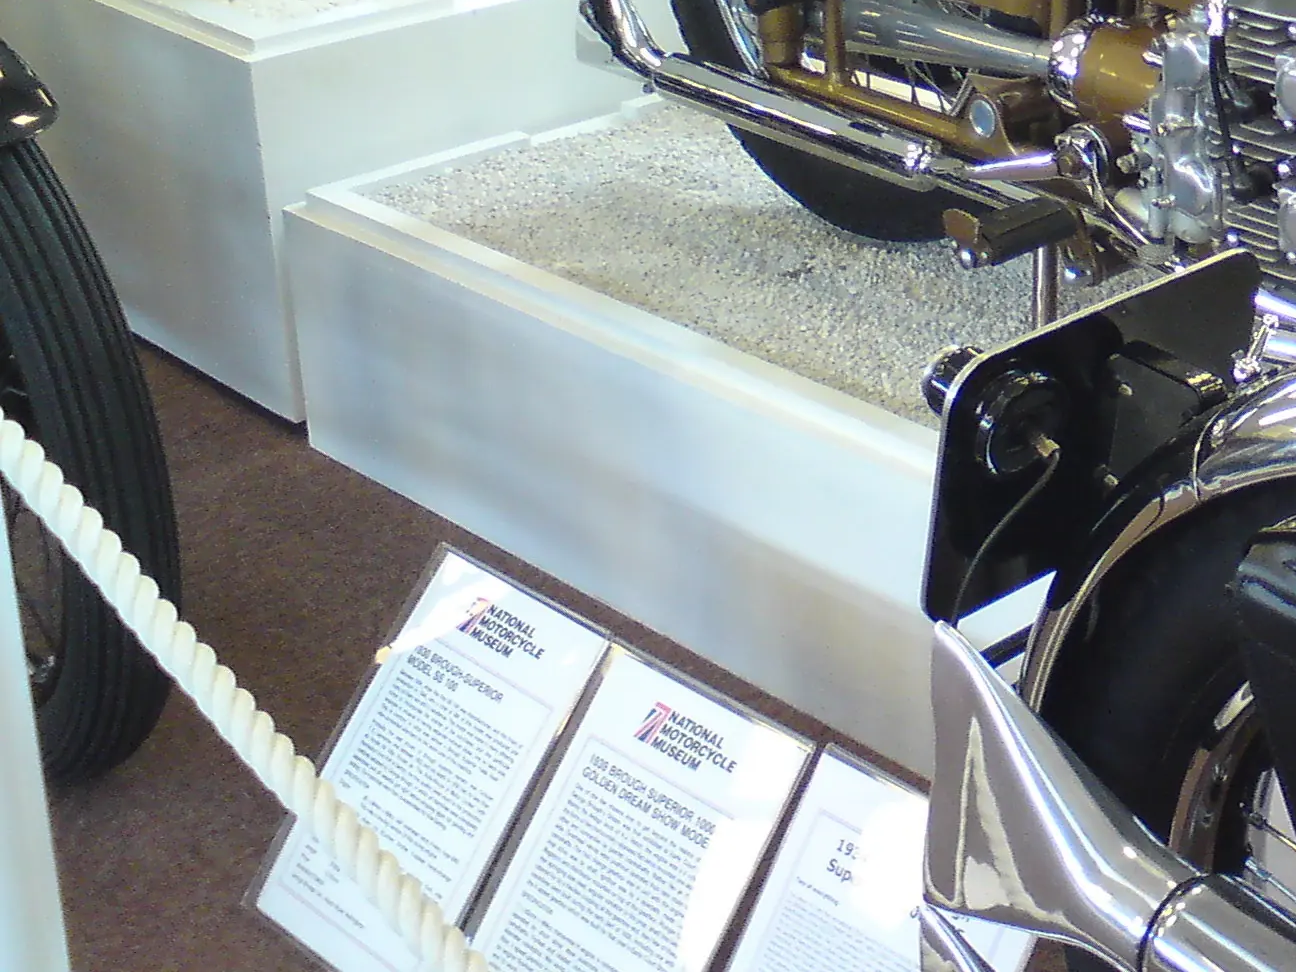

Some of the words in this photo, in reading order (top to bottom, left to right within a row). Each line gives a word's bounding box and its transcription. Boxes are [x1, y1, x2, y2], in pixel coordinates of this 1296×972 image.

[479, 615, 546, 660] MOTORCYCLE
[487, 604, 537, 639] NATIONAL
[469, 627, 515, 658] MUSEUM
[406, 654, 432, 677] MODEL
[659, 723, 738, 773] MOTORCYCLE
[668, 710, 725, 750] NATIONAL
[651, 736, 703, 772] MUSEUM
[582, 766, 619, 795] GOLDEN
[618, 787, 652, 814] DREAM
[651, 807, 681, 831] SHOW
[681, 823, 712, 850] MODE
[608, 764, 648, 794] BROUGH
[647, 787, 695, 822] SUPERIOR
